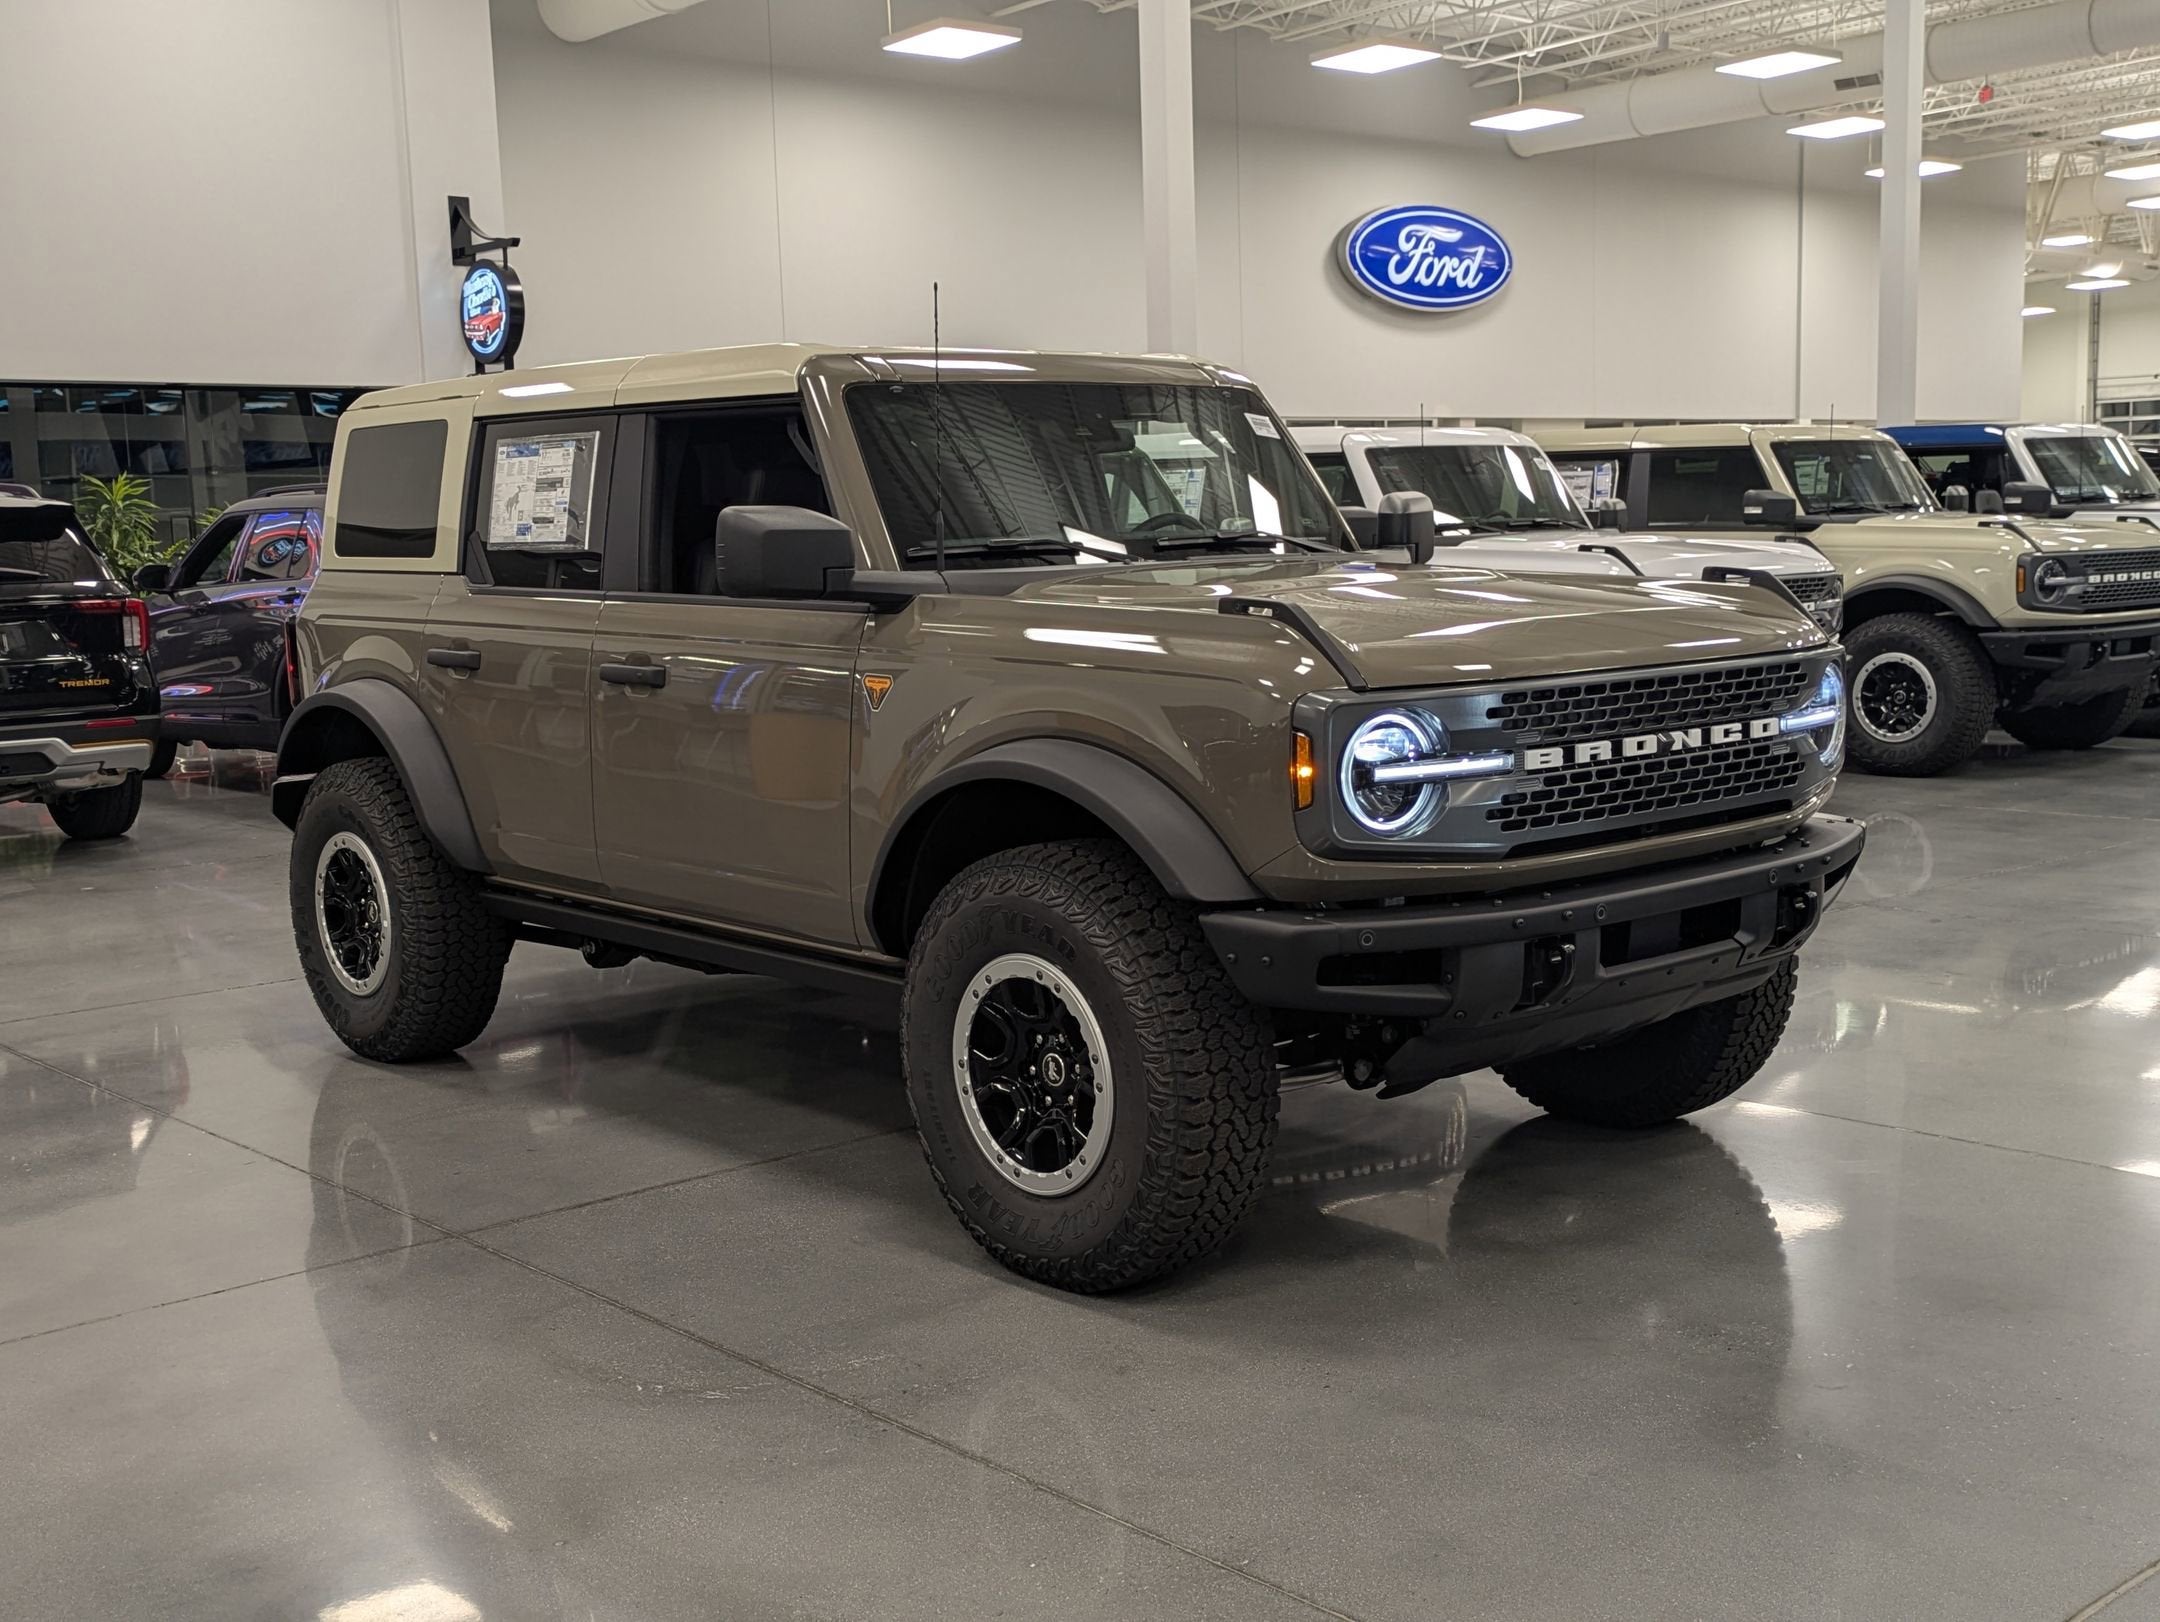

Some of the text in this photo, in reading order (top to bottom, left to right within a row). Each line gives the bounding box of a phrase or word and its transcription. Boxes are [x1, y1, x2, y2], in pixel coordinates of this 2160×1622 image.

[1387, 223, 1486, 290] Ford
[2088, 570, 2160, 584] BRONCO
[59, 678, 110, 688] TREMOR
[1524, 717, 1780, 770] BRONCO
[925, 902, 1077, 1004] GOODYEAR
[966, 1157, 1126, 1252] GOODYEAR
